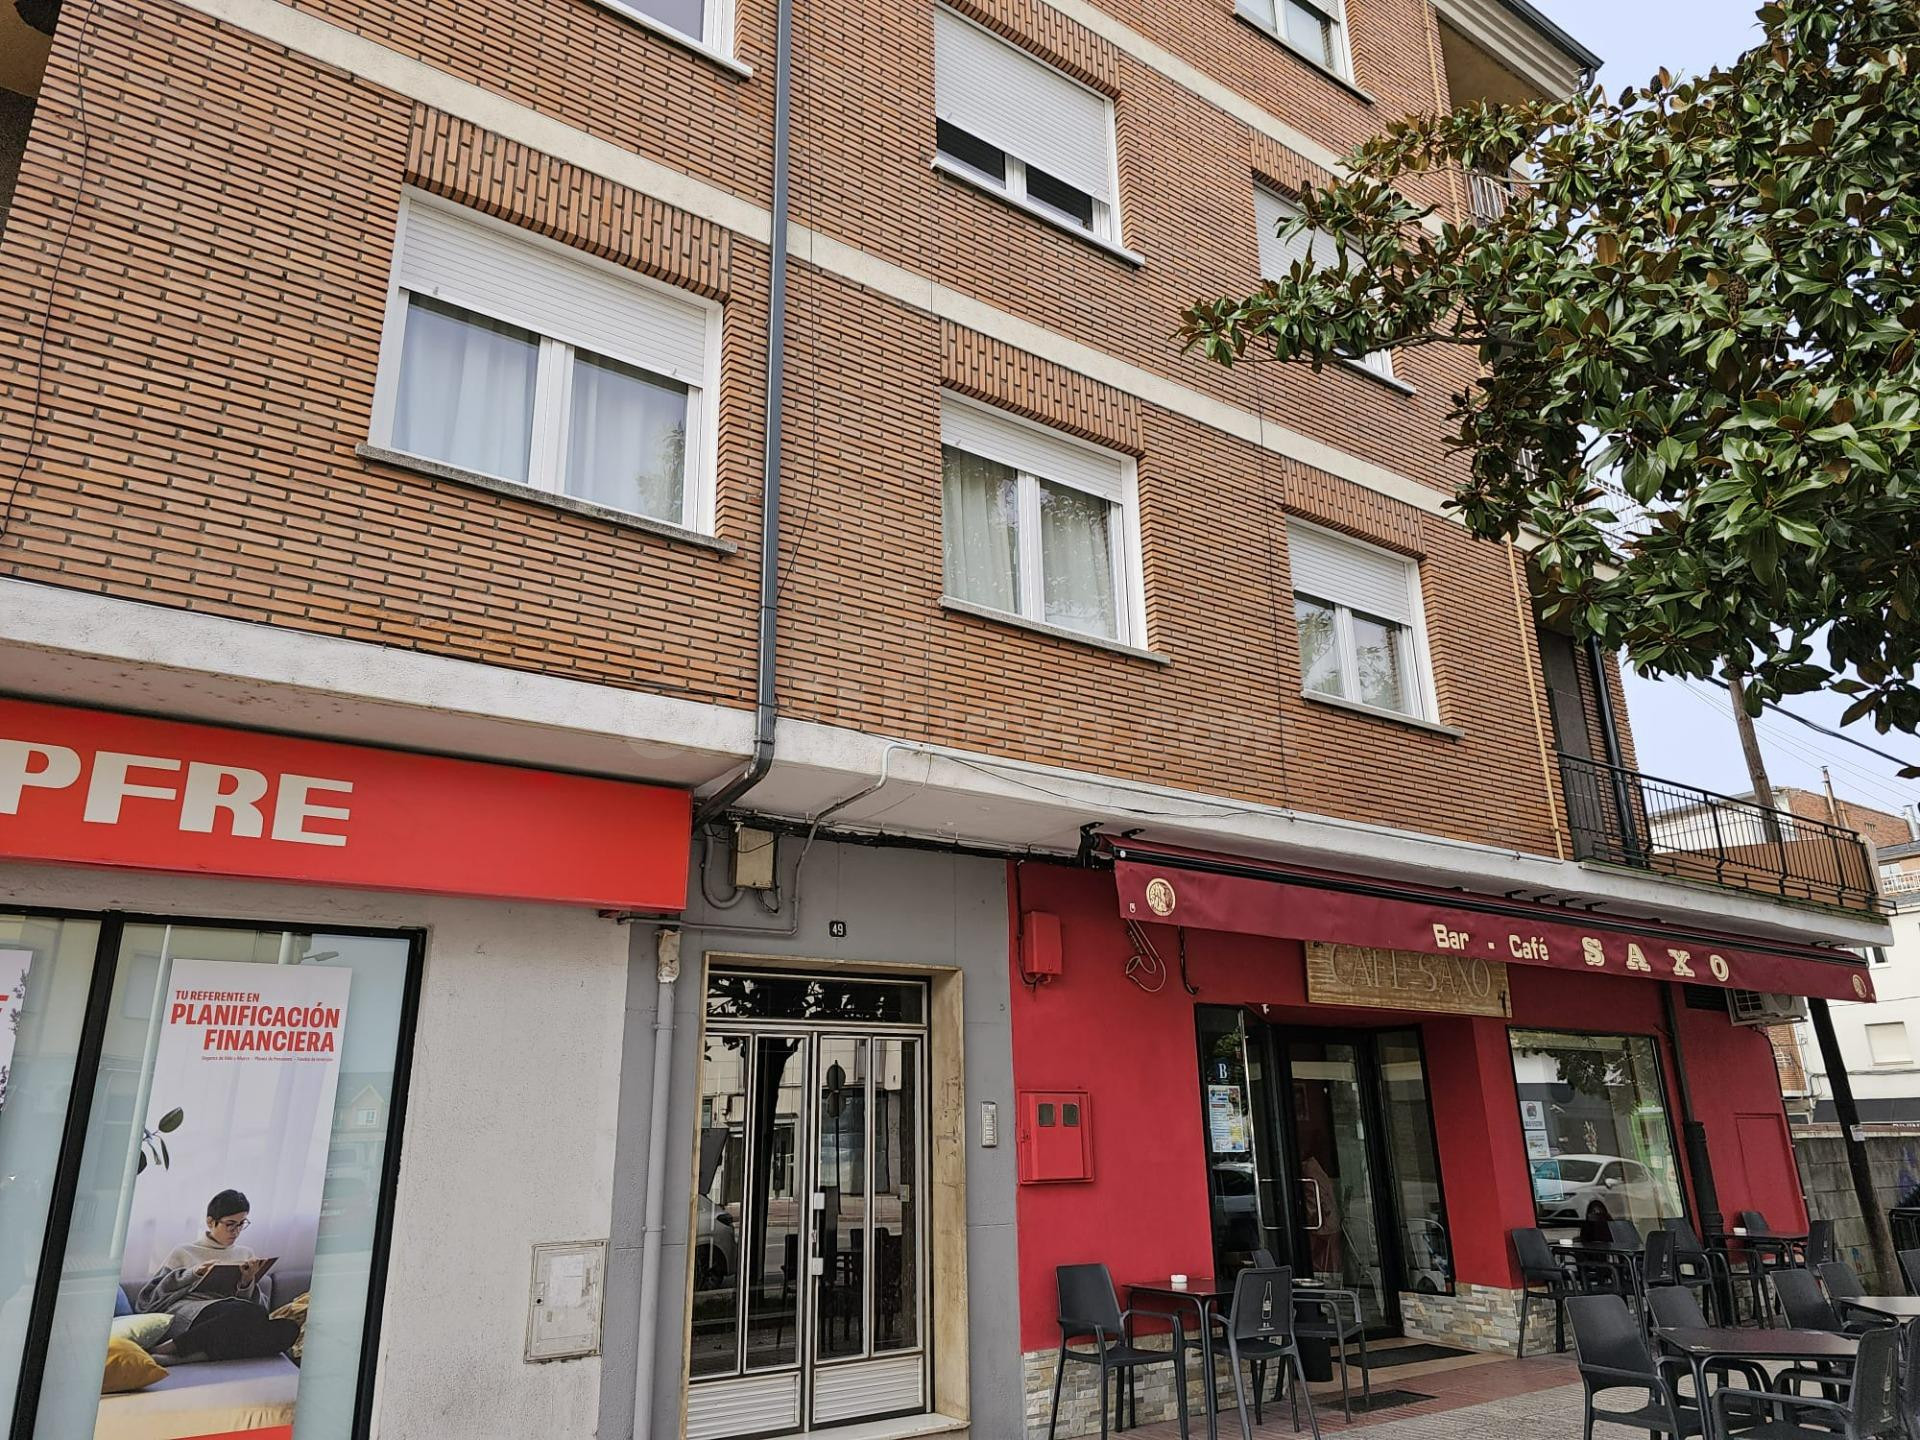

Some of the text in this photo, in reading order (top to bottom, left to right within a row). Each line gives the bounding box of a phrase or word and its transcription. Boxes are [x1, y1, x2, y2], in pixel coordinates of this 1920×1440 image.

[832, 923, 844, 936] 49
[1432, 923, 1729, 982] Bar Café SAXO
[1417, 952, 1491, 999] SAXO
[176, 990, 260, 1003] TU REFERENTE EN
[170, 1001, 340, 1029] PLANIFICACIÓN
[203, 1029, 335, 1053] FINANCIERA
[1218, 1063, 1228, 1079] B
